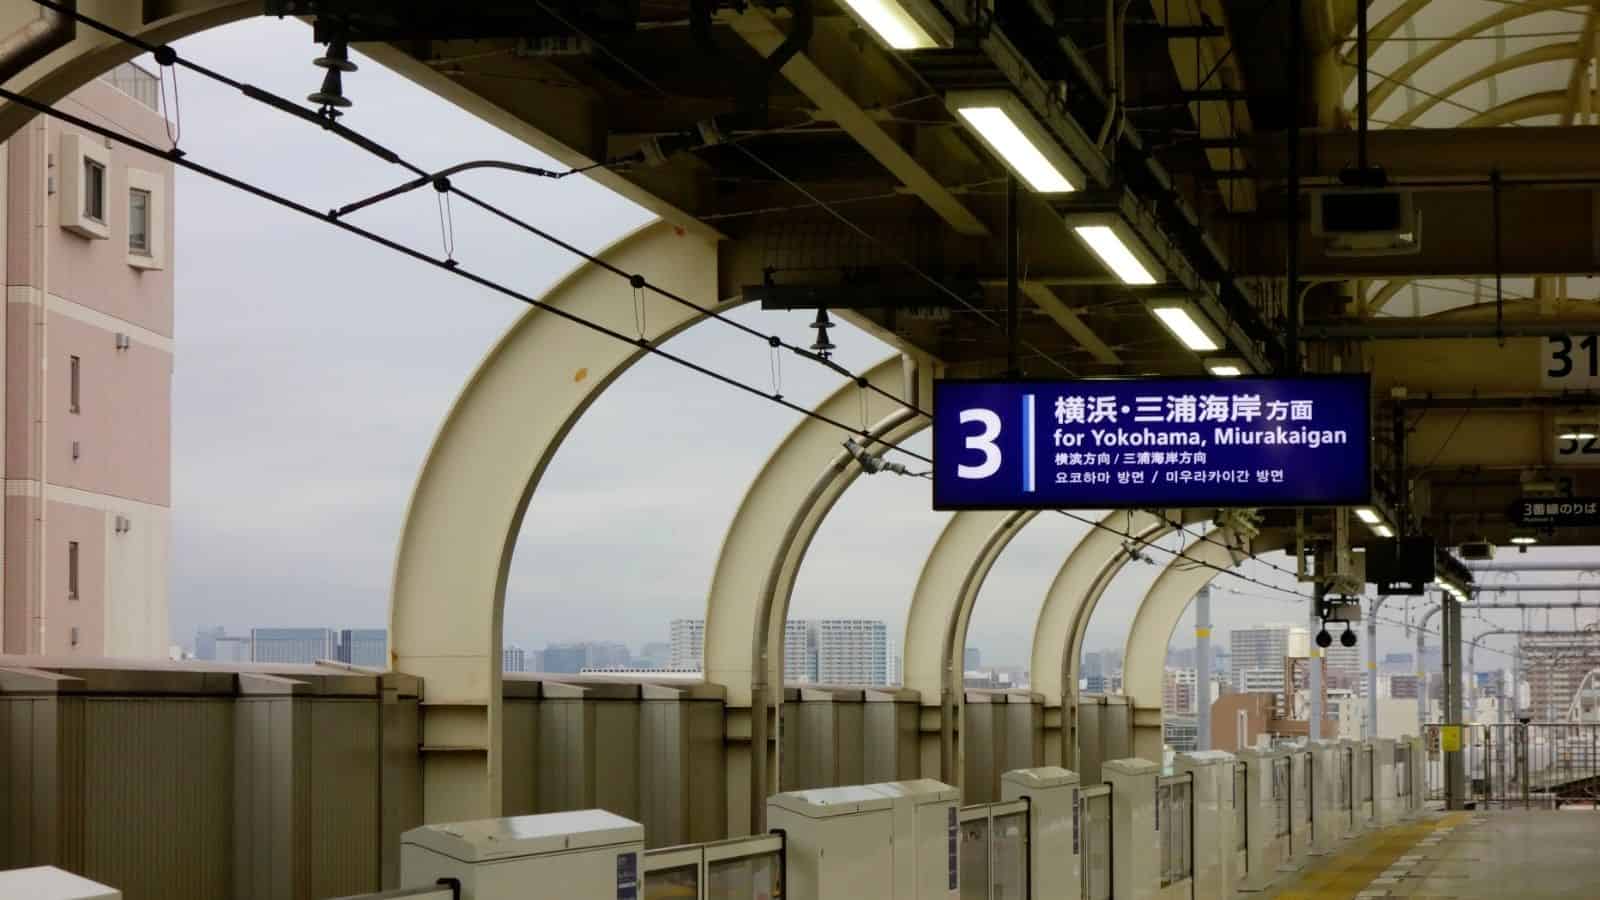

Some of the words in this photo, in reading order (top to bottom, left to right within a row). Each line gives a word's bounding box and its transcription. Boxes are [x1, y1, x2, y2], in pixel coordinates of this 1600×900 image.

[957, 408, 1002, 480] 3
[1053, 428, 1085, 447] for
[1090, 427, 1207, 448] Yokohama,
[1214, 425, 1347, 449] Miurakaigan
[1055, 471, 1111, 485] 요코하마
[1117, 471, 1145, 485] 방면
[1165, 469, 1251, 484] 미우라카이간
[1256, 469, 1285, 483] 방면
